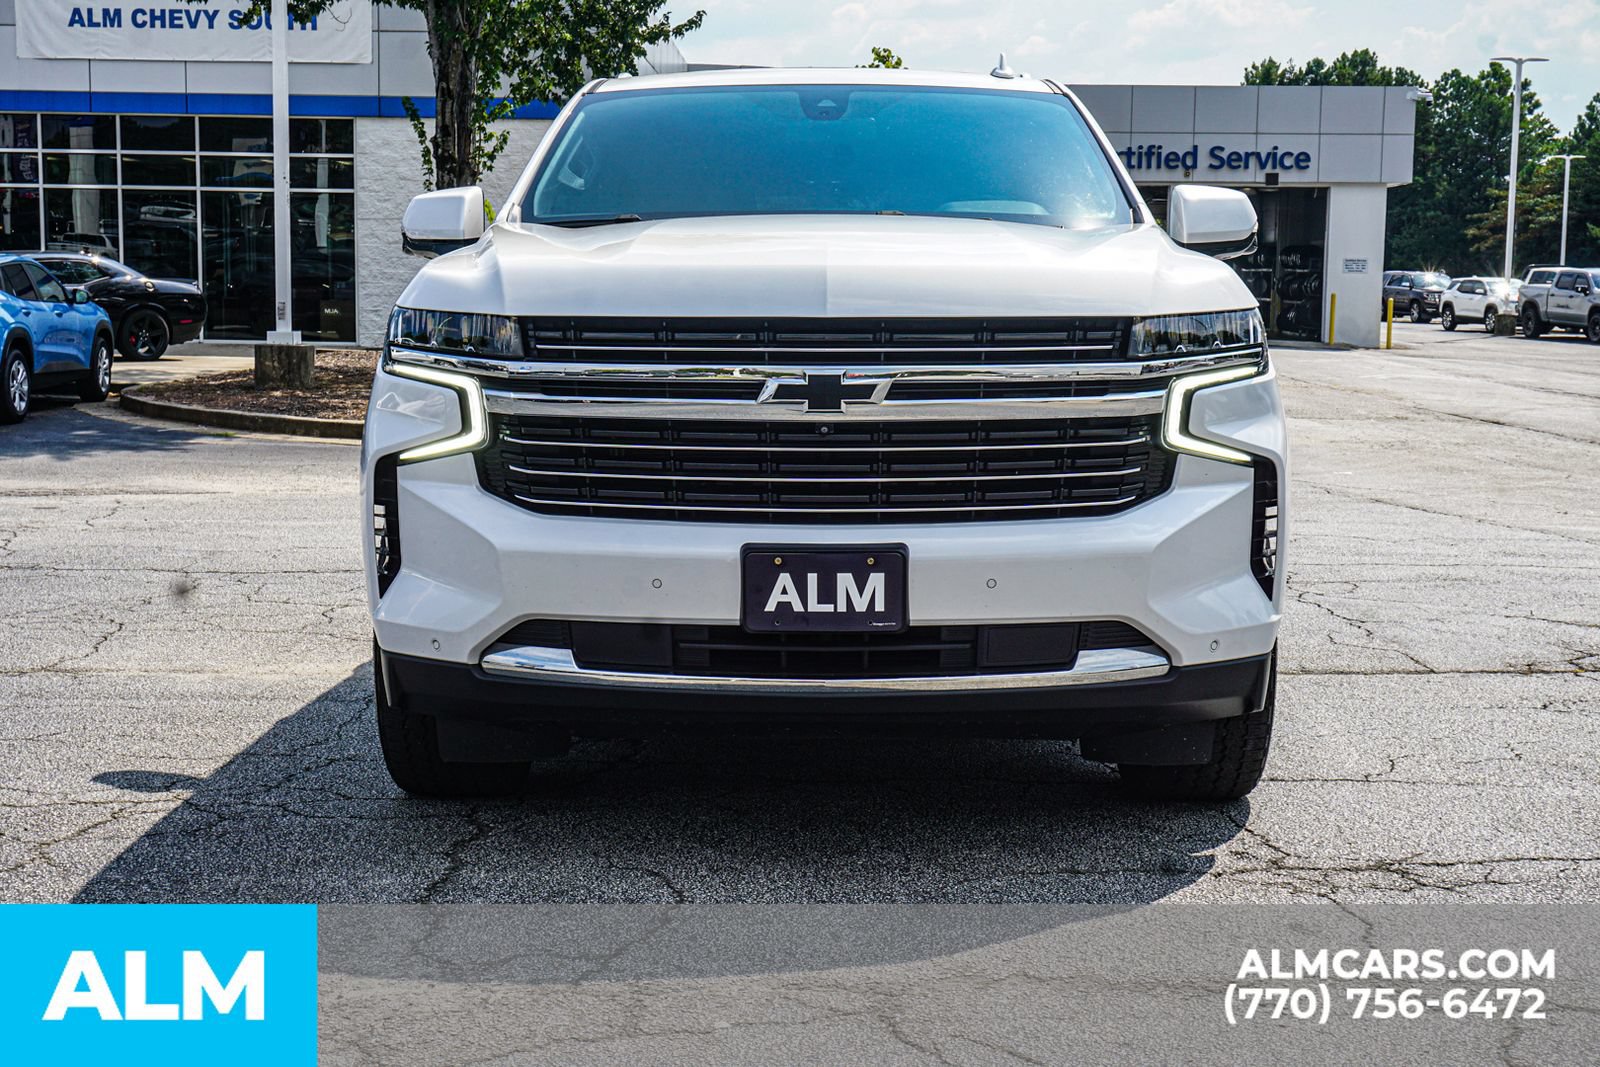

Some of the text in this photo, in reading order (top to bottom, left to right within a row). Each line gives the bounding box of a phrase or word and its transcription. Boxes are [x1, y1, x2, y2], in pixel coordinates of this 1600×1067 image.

[68, 8, 122, 28] ALM
[130, 8, 220, 30] CHEVY
[1208, 145, 1311, 170] Service
[764, 572, 886, 613] ALM
